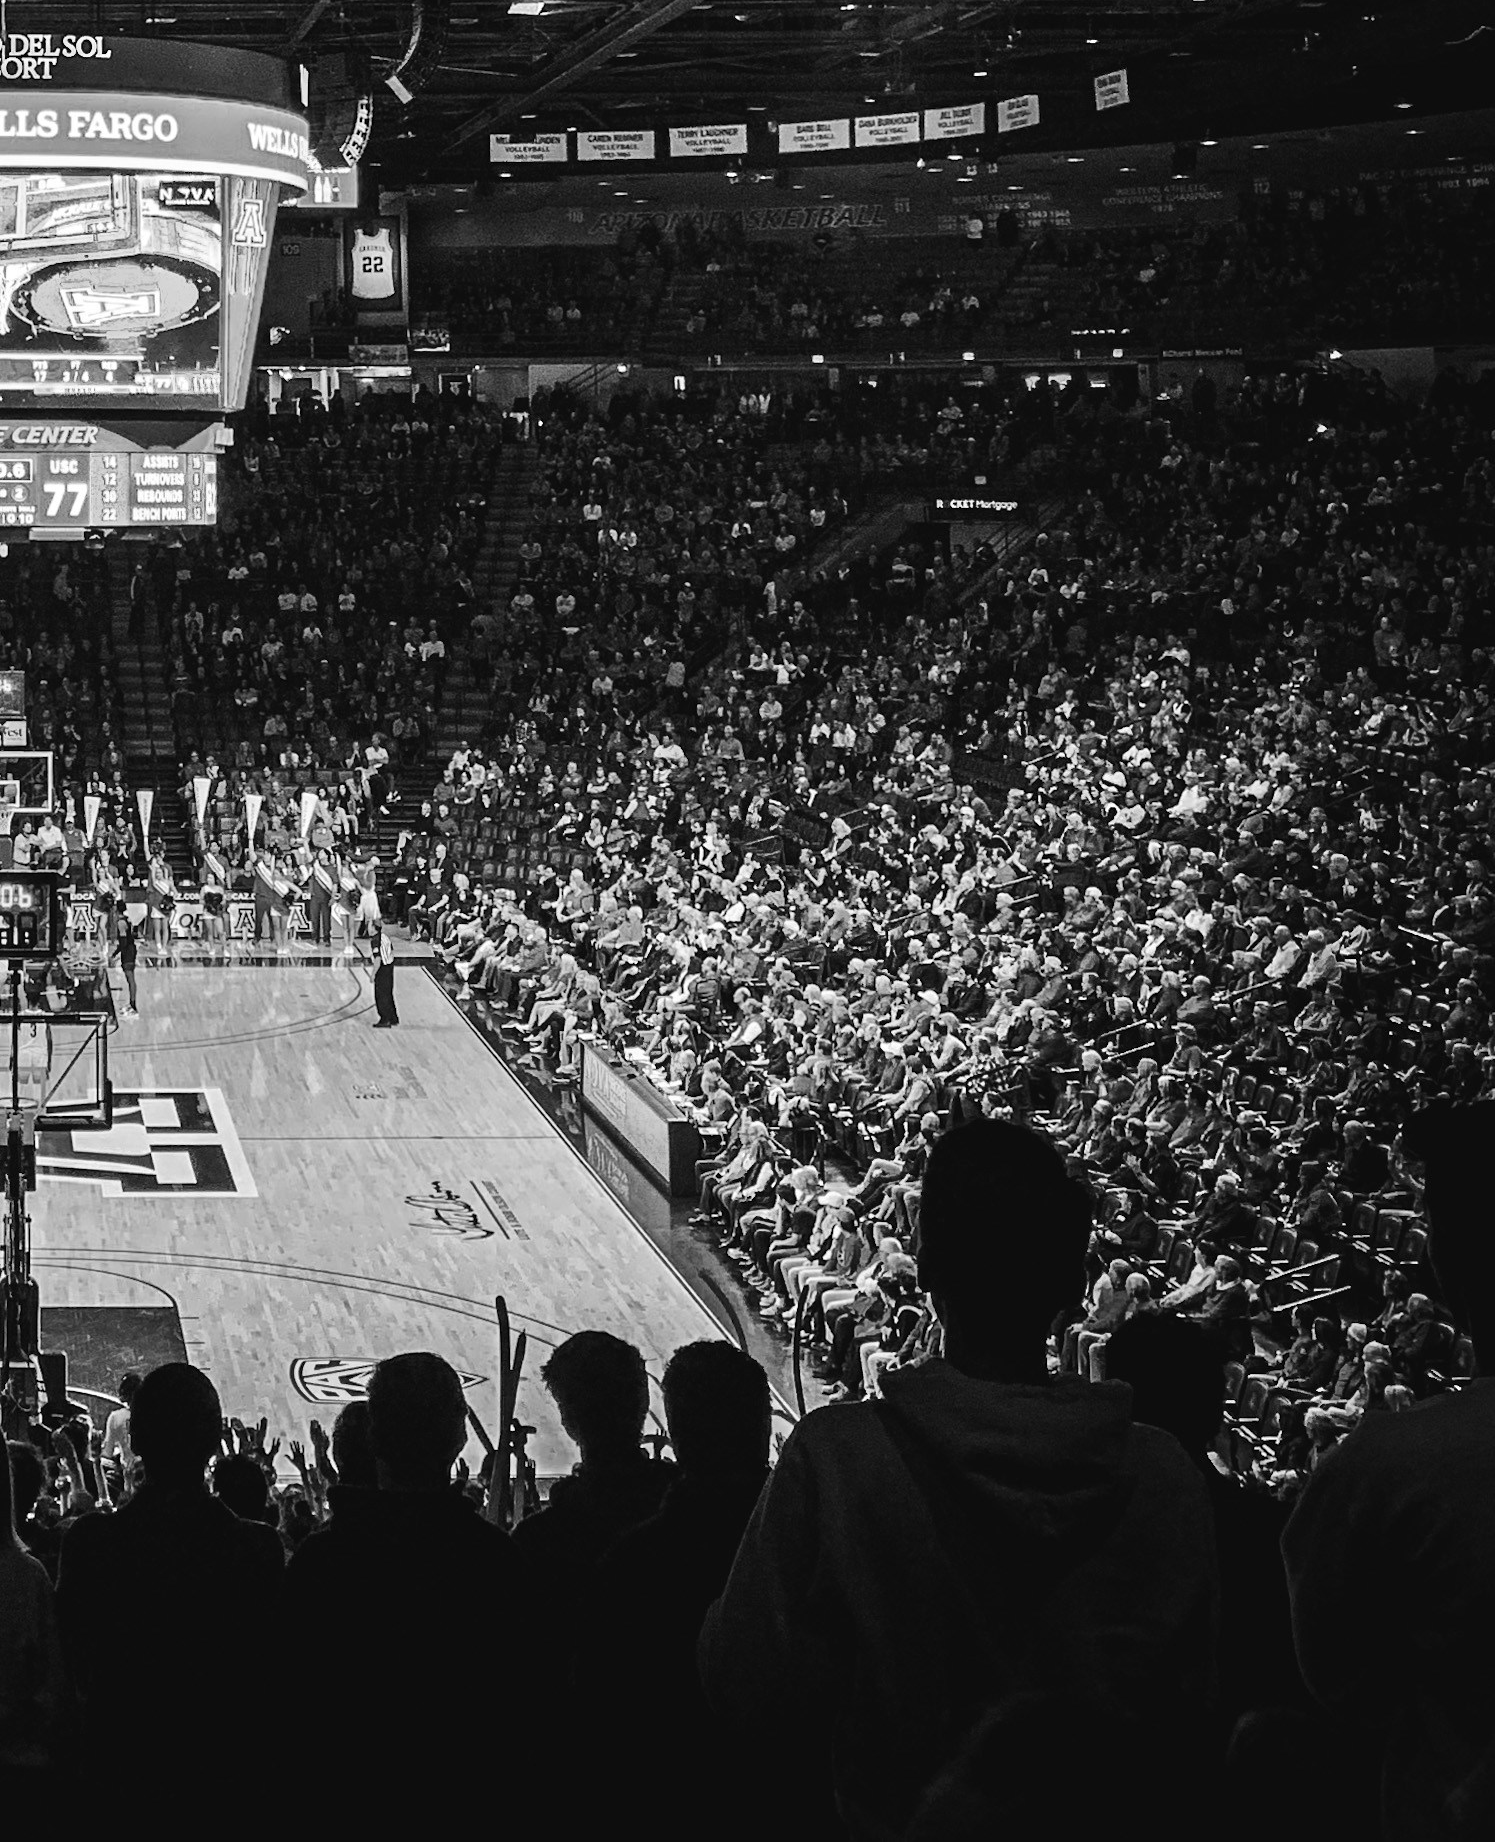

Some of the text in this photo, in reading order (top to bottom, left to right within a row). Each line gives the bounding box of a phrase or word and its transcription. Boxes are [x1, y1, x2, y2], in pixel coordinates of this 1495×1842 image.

[8, 34, 63, 57] DEL
[63, 36, 112, 58] SOL
[67, 111, 179, 142] FARGO
[248, 123, 298, 159] WELLS
[505, 145, 551, 153] VOLLEYBALL
[362, 256, 384, 273] 22
[34, 371, 47, 382] 17
[11, 425, 100, 445] CENTER
[49, 459, 79, 474] USC
[103, 455, 179, 469] 14 ASSISTS
[103, 472, 185, 486] 12 TURNOVERS
[43, 482, 88, 517] 77
[136, 489, 184, 503] REBOUNDS
[935, 498, 1019, 511] RCKET Mortgage
[103, 507, 187, 521] 22 BENCH POINTS
